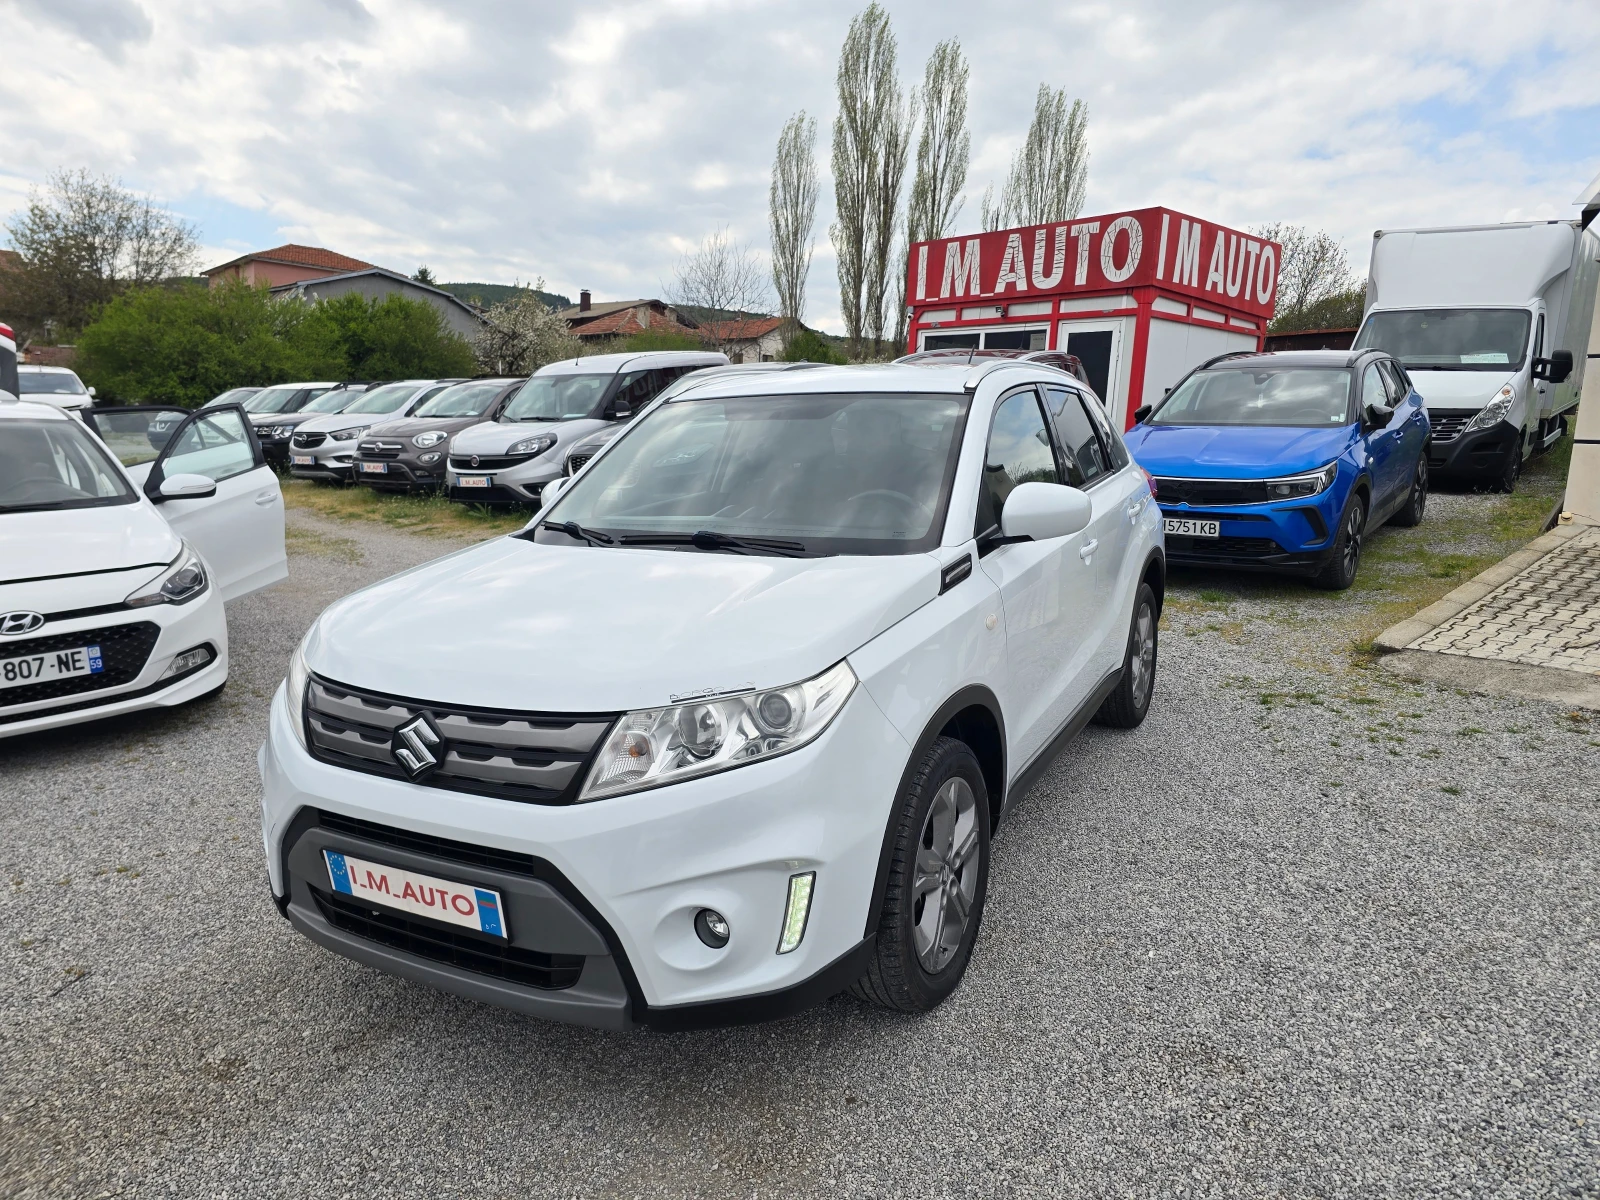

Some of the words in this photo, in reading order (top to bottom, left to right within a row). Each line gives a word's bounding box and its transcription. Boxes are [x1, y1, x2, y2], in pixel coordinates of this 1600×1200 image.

[1156, 213, 1170, 280] I
[1172, 218, 1202, 288] M
[1205, 230, 1275, 305] AUTO
[90, 658, 103, 669] 59
